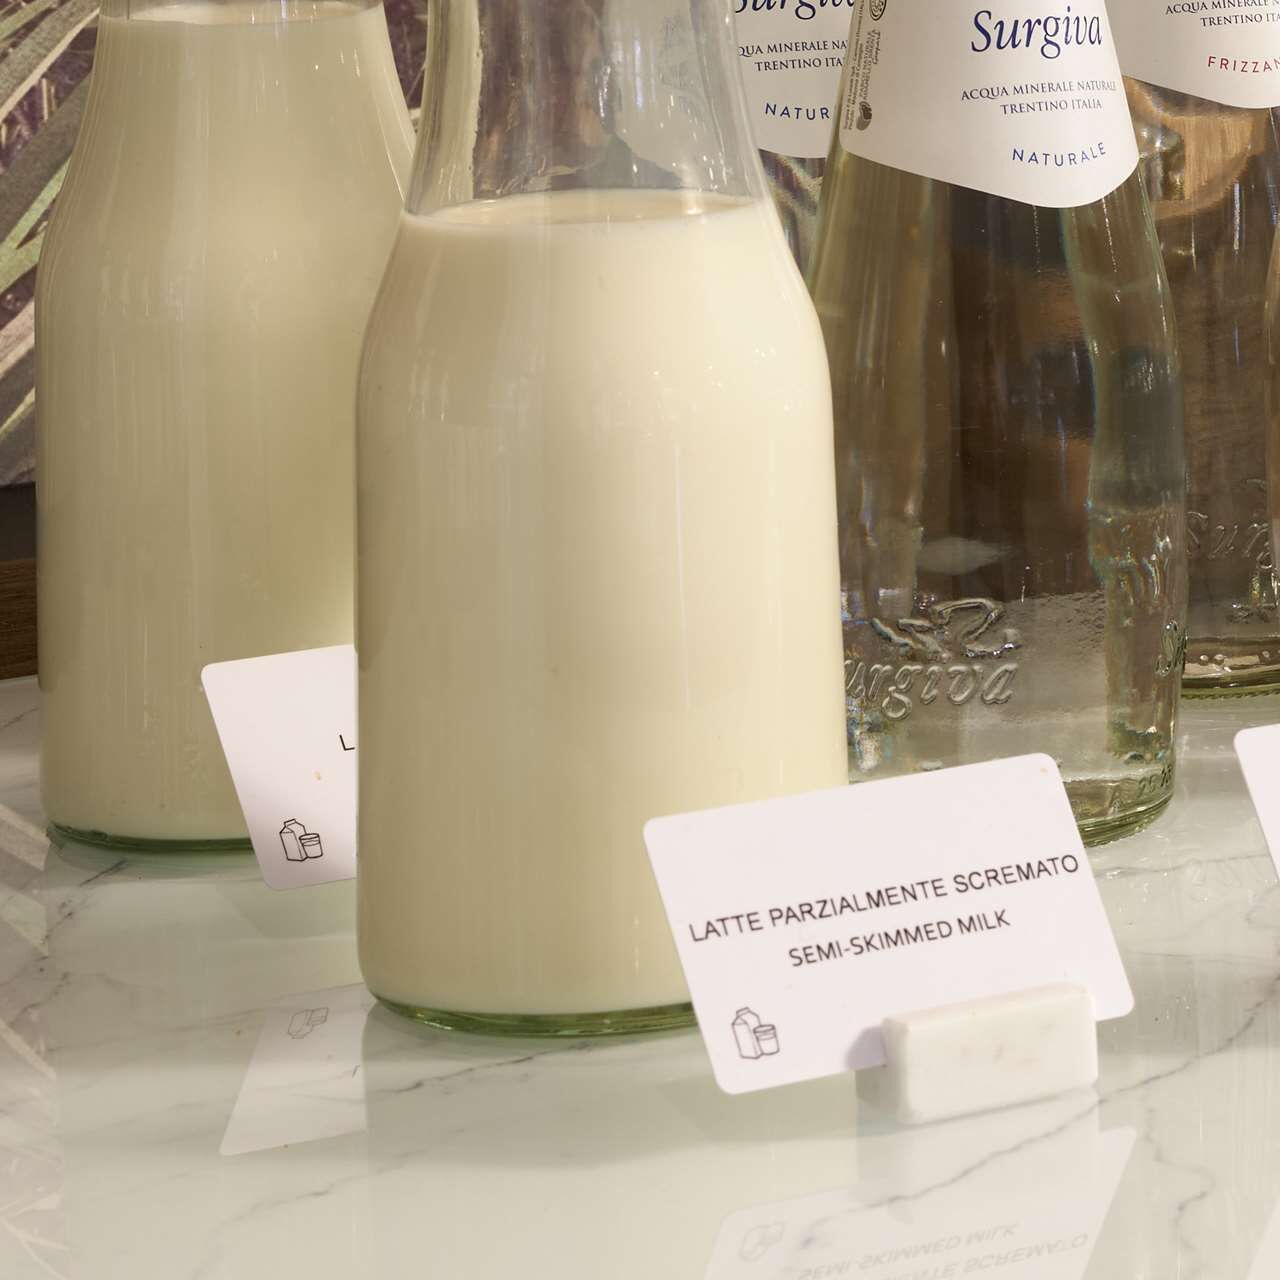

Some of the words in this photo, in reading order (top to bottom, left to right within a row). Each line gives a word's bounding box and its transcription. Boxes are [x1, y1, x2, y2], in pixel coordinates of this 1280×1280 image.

[1165, 2, 1208, 15] ACQUA
[1200, 13, 1263, 27] TRENTINO
[971, 5, 1103, 59] Surgiva
[738, 45, 763, 58] QUA
[767, 40, 829, 54] MINERALE
[755, 57, 822, 72] TRENTINO
[825, 57, 843, 68] ITA
[961, 86, 1009, 101] ACQUA
[1012, 81, 1074, 95] MINERALE
[765, 103, 830, 120] NATUR
[1000, 100, 1068, 115] TRENTINO
[1071, 98, 1102, 110] ITALIA
[1012, 142, 1106, 167] NATURALE
[844, 658, 1019, 719] urgiva
[689, 912, 763, 942] LATTE
[769, 878, 948, 927] PARZIALMENTE
[953, 854, 1079, 893] SCREMATO
[789, 920, 952, 967] SEMI-SKIMMED
[958, 909, 1011, 934] MILK
